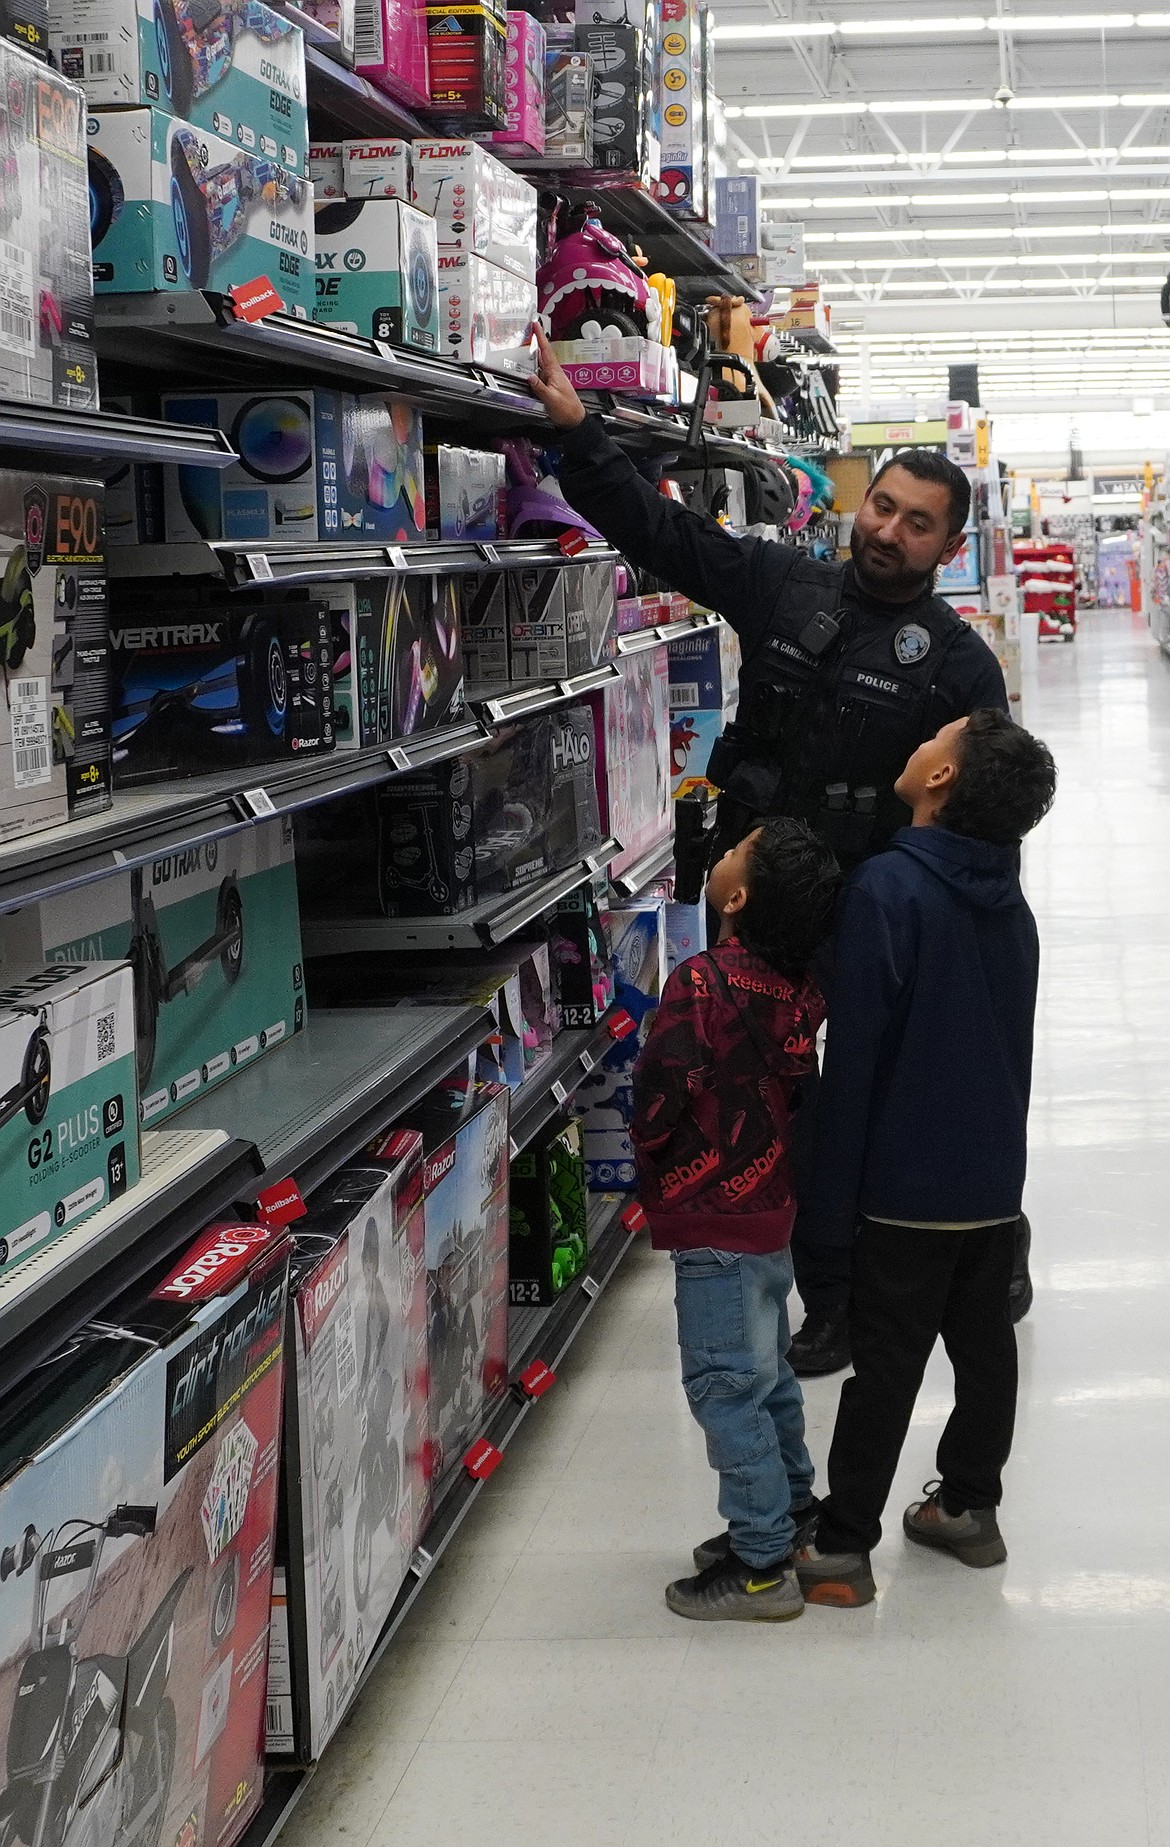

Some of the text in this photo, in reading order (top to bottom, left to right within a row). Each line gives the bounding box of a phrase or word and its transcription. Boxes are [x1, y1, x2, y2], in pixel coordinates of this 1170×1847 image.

[27, 24, 40, 43] 8+
[260, 59, 291, 91] GOTRAX
[269, 89, 291, 118] EDGE
[448, 91, 461, 100] 5+
[349, 146, 395, 160] FLOW
[419, 146, 465, 159] FLOW
[269, 220, 299, 249] GOTRAX
[279, 251, 300, 277] EDGE
[239, 289, 275, 310] Rollback
[378, 322, 395, 338] 8+
[978, 445, 987, 454] H
[57, 495, 97, 554] E90
[109, 622, 222, 651] VERTRAX
[771, 639, 779, 647] M.
[856, 673, 899, 693] POLICE
[299, 738, 319, 748] Razor
[89, 764, 100, 782] 8+
[515, 856, 545, 877] SUPREME
[727, 973, 796, 1002] Reebok
[563, 1007, 592, 1026] 12-2
[28, 1104, 100, 1170] G2 PLUS
[29, 1137, 101, 1187] FOLDING E-SCOOTER
[111, 1162, 124, 1184] 13+
[432, 1150, 456, 1181] Razor
[720, 1137, 784, 1201] Reebok
[265, 1192, 299, 1215] Rollback
[163, 1240, 249, 1298] Razor
[314, 1256, 348, 1318] Razor
[509, 1282, 540, 1302] 12-2
[176, 1434, 198, 1464] YOUTH
[198, 1413, 218, 1443] SPORT
[472, 1446, 494, 1471] Rollback
[235, 1780, 249, 1805] 8+
